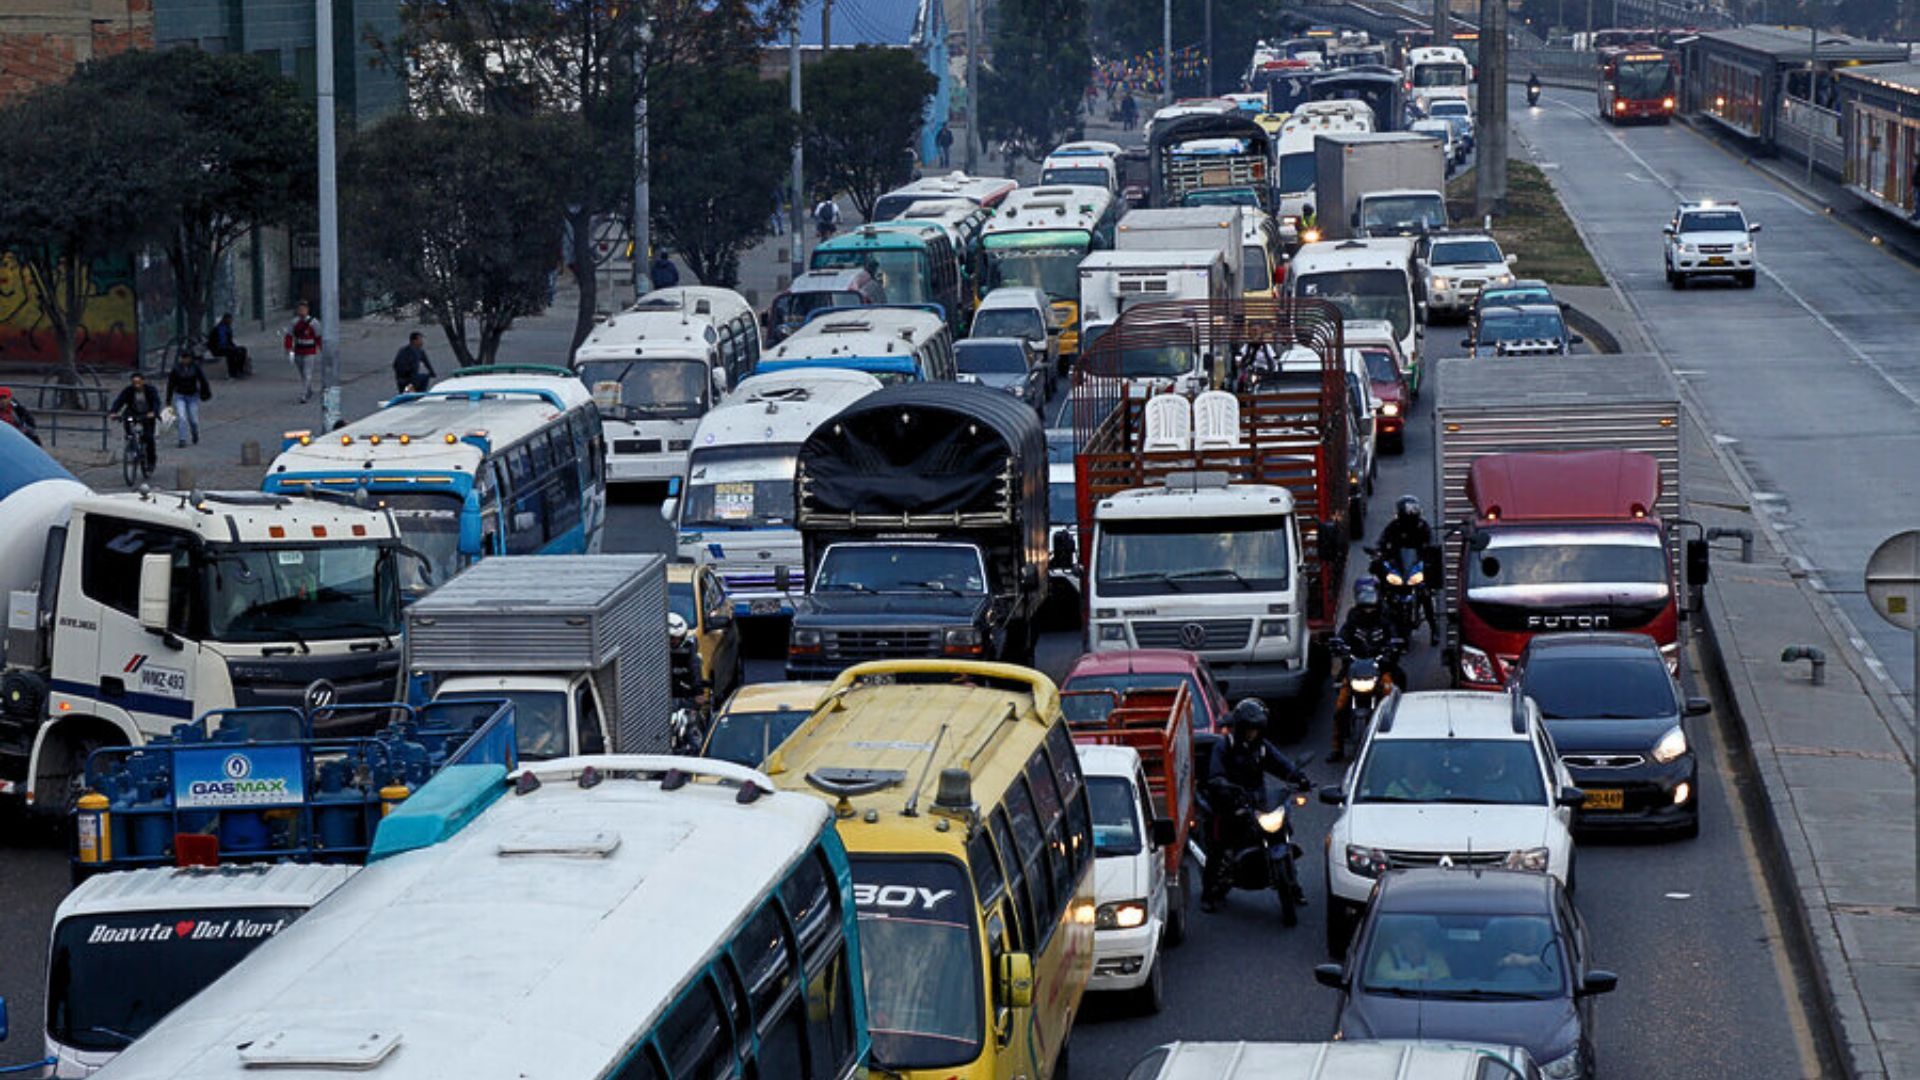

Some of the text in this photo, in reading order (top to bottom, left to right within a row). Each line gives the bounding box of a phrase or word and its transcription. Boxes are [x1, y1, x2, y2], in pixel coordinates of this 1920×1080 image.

[142, 669, 185, 690] WMZ-493
[191, 780, 284, 795] GASMAX
[88, 924, 173, 943] Boavita
[191, 920, 230, 939] Del
